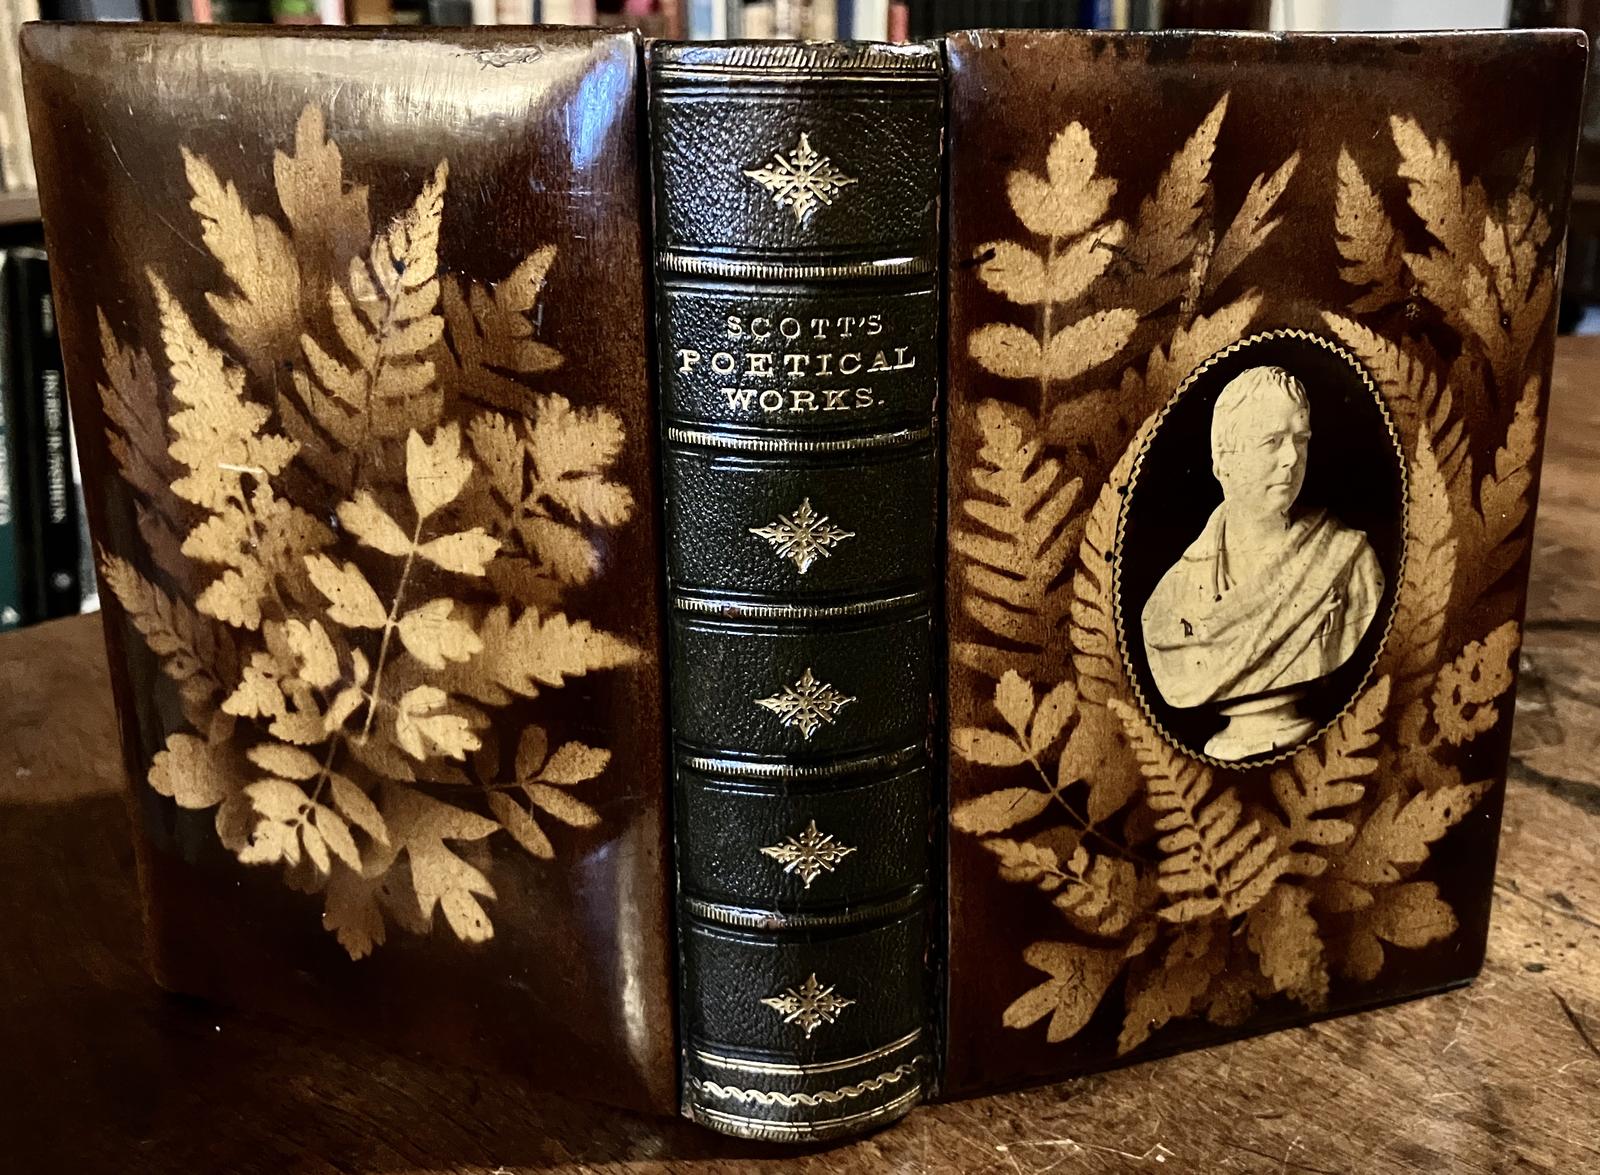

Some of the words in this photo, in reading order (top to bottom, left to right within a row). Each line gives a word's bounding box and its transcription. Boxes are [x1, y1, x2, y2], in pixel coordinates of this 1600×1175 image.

[727, 314, 883, 341] SCOTT'S
[678, 346, 916, 378] POETICAL
[721, 386, 885, 412] WORKS.
